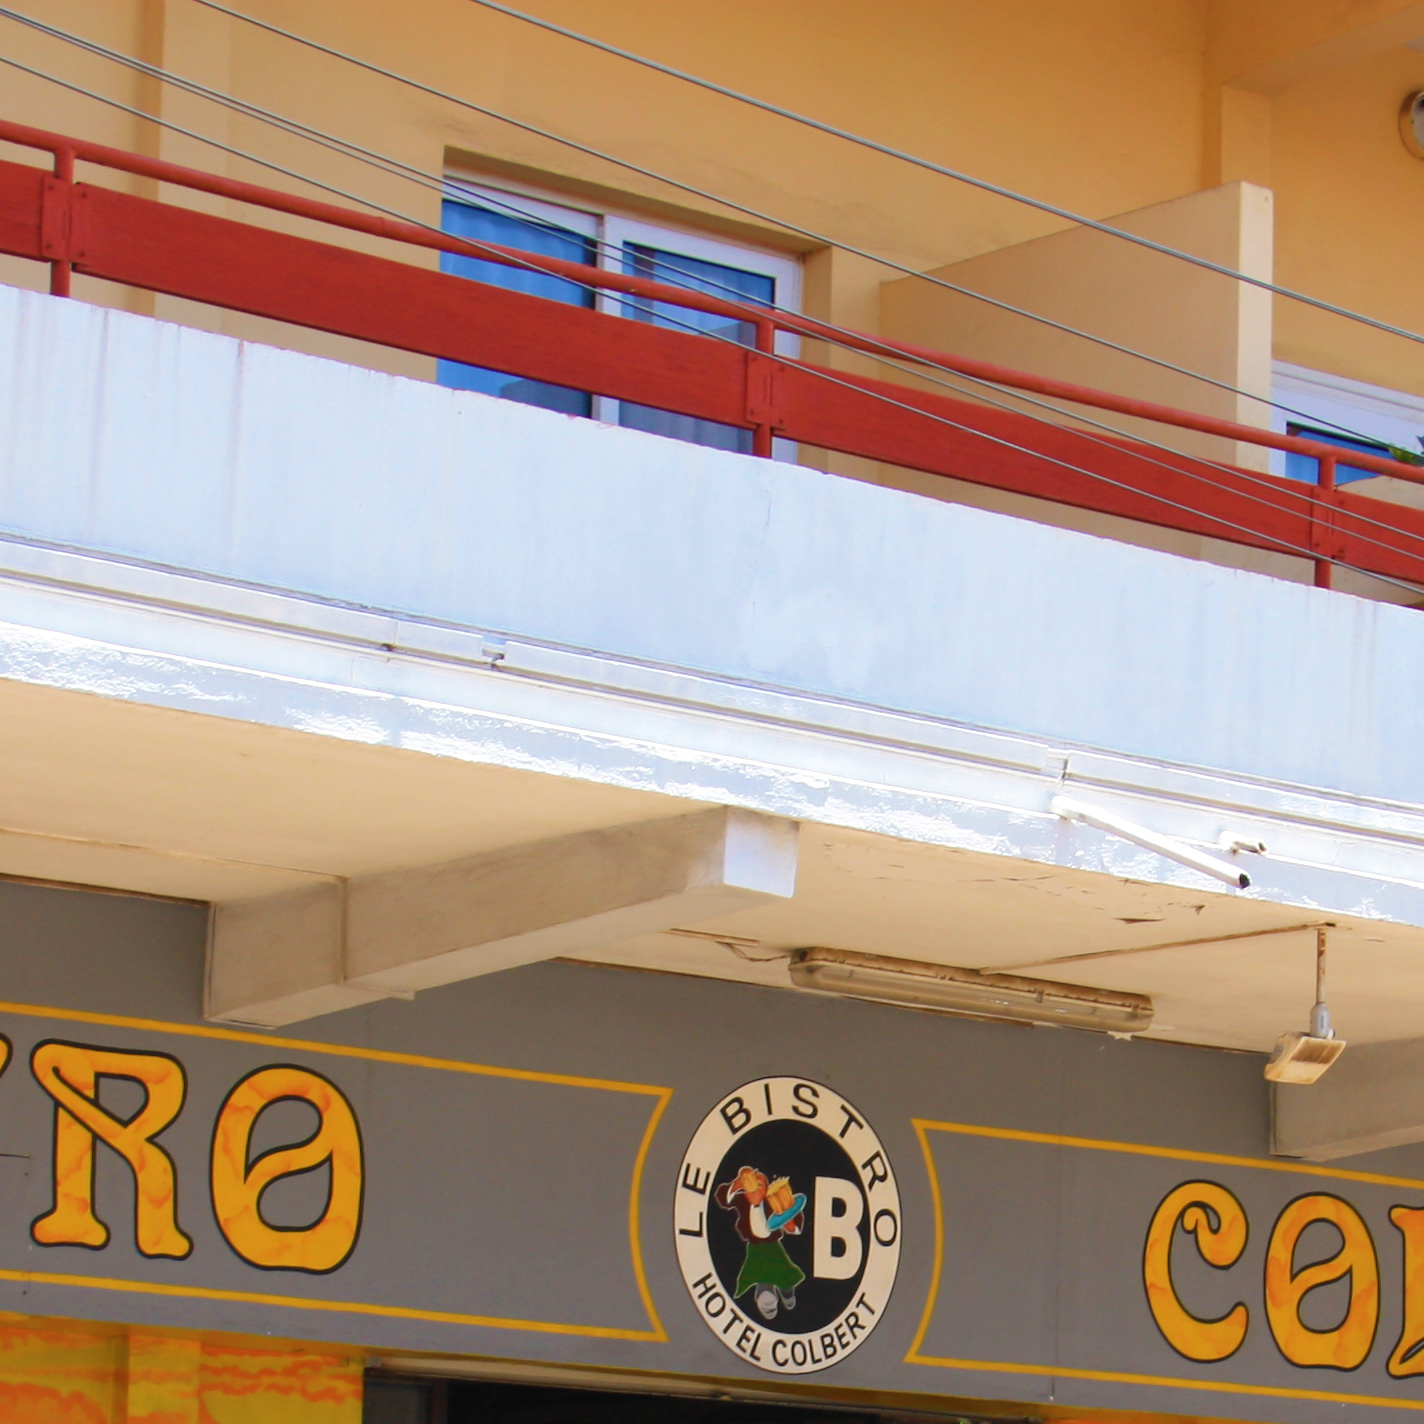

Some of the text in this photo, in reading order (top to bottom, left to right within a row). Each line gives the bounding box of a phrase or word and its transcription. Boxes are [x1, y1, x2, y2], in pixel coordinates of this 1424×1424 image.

[678, 1082, 897, 1247] LE BISTRO
[813, 1175, 864, 1280] B
[692, 1272, 877, 1367] HOTEL COLBERT
